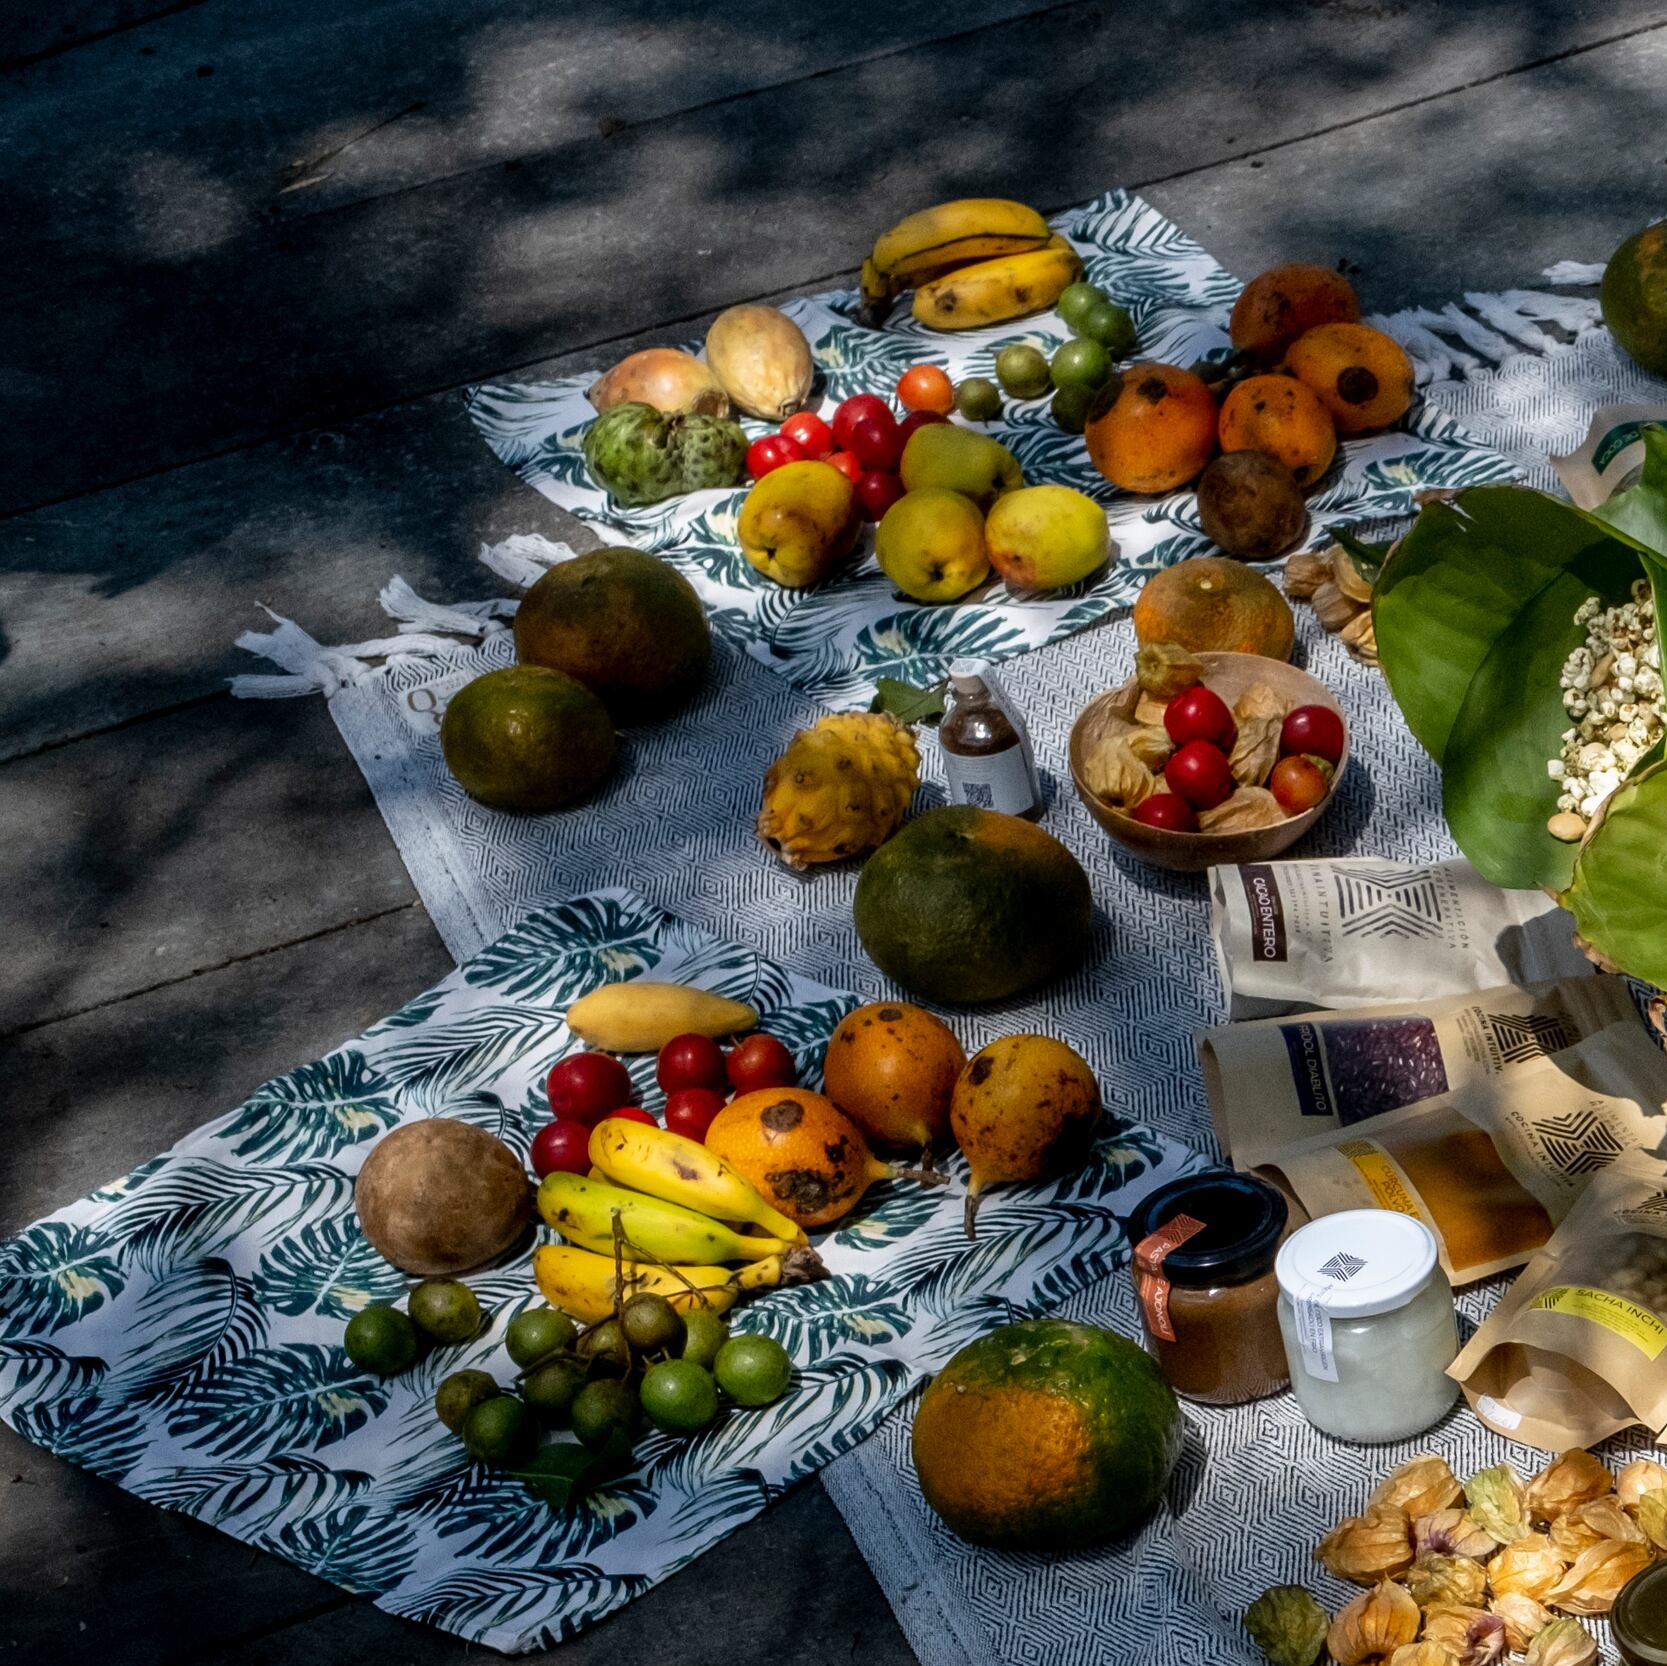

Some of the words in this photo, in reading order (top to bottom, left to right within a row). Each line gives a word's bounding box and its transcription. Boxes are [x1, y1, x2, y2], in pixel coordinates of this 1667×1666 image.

[1253, 877, 1270, 905] CACAO
[1260, 906, 1277, 958] ENTERO
[1485, 1032, 1503, 1074] INTUITIV
[1306, 1058, 1327, 1111] DIABLITO
[1511, 1111, 1540, 1148] COCINA
[1380, 1181, 1406, 1214] POLVO
[1574, 1288, 1624, 1309] SACHA
[1625, 1304, 1665, 1335] INCHI
